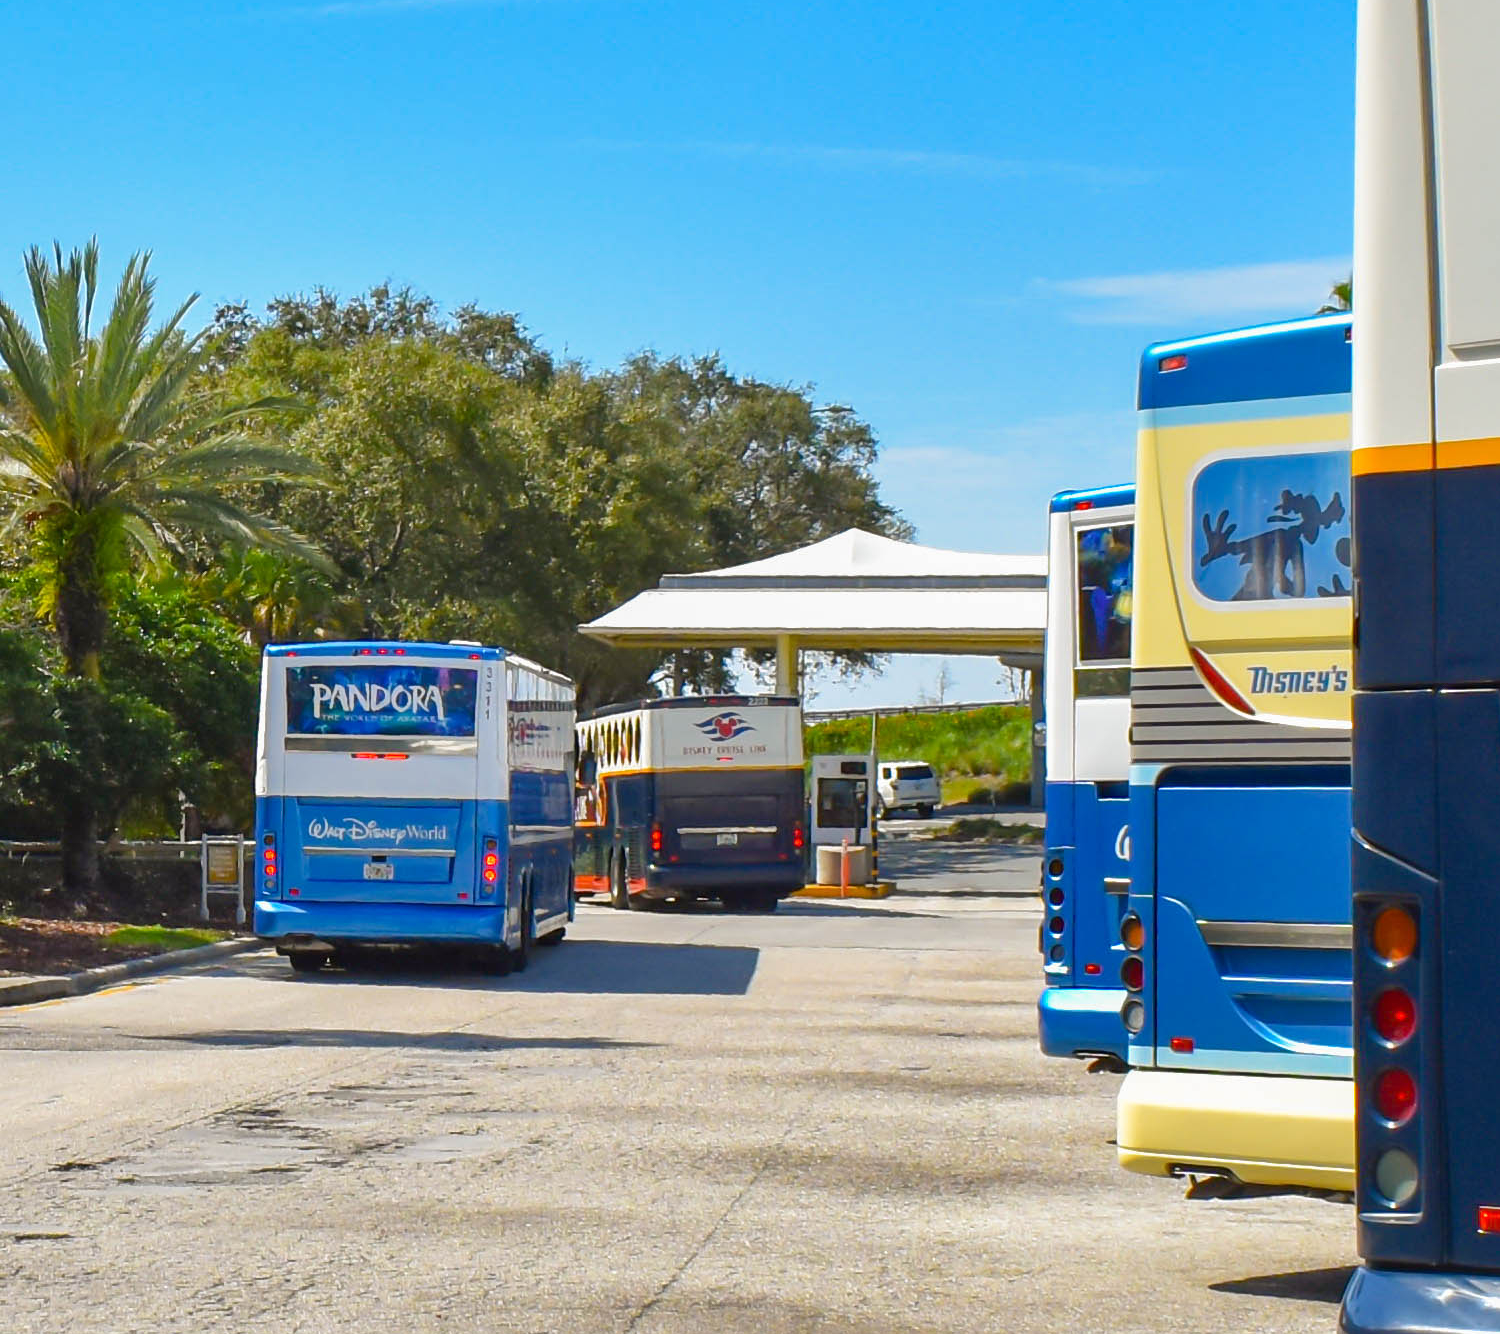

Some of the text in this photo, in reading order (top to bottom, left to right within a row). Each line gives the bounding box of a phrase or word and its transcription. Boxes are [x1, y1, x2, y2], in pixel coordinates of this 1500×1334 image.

[310, 682, 445, 720] PANDORA
[485, 666, 494, 721] 3311
[322, 713, 437, 724] THE WORLD OF AVATAR
[406, 824, 447, 841] World
